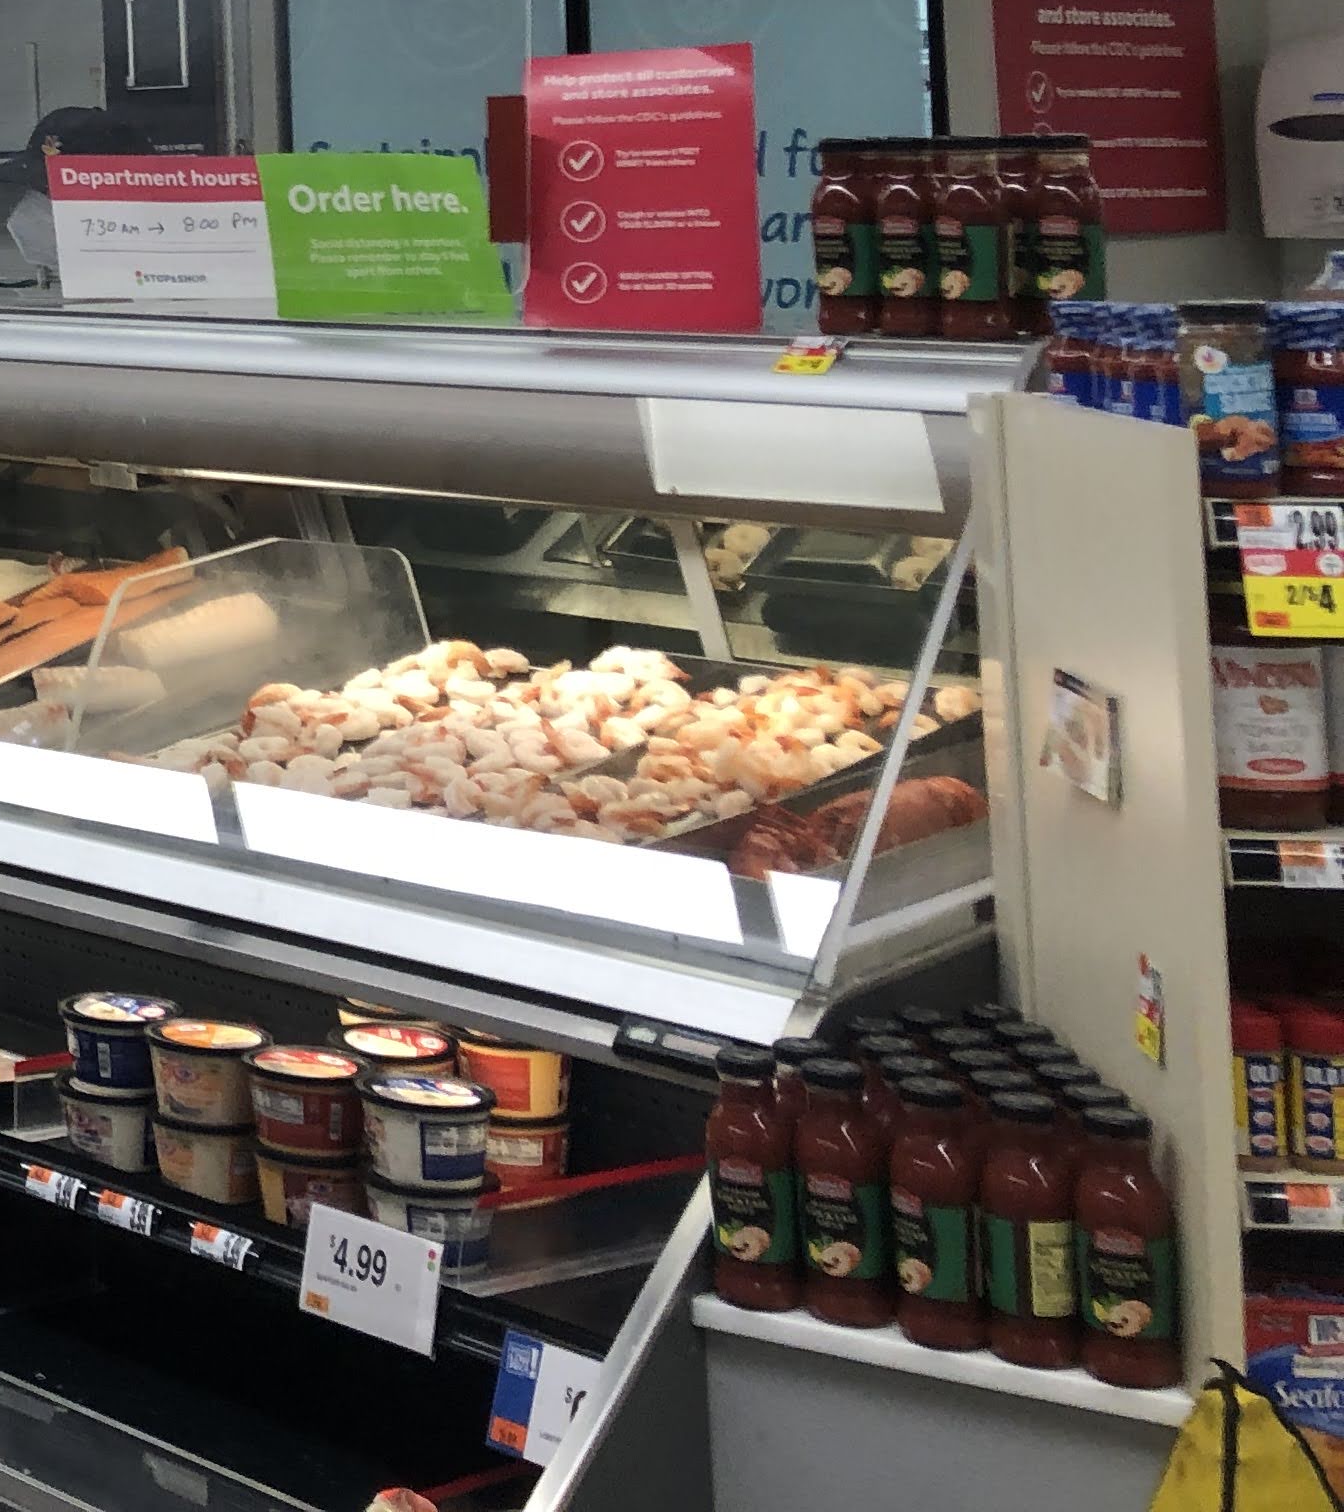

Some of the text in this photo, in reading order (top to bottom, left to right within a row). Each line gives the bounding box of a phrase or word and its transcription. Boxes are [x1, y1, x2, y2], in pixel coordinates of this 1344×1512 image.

[1038, 7, 1176, 28] and store associates.
[543, 74, 578, 87] Help
[578, 71, 632, 86] protect
[562, 89, 589, 101] and
[590, 87, 628, 100] store
[61, 167, 258, 189] Department hours:
[288, 183, 469, 214] Order here.
[329, 1234, 387, 1288] $4.99
